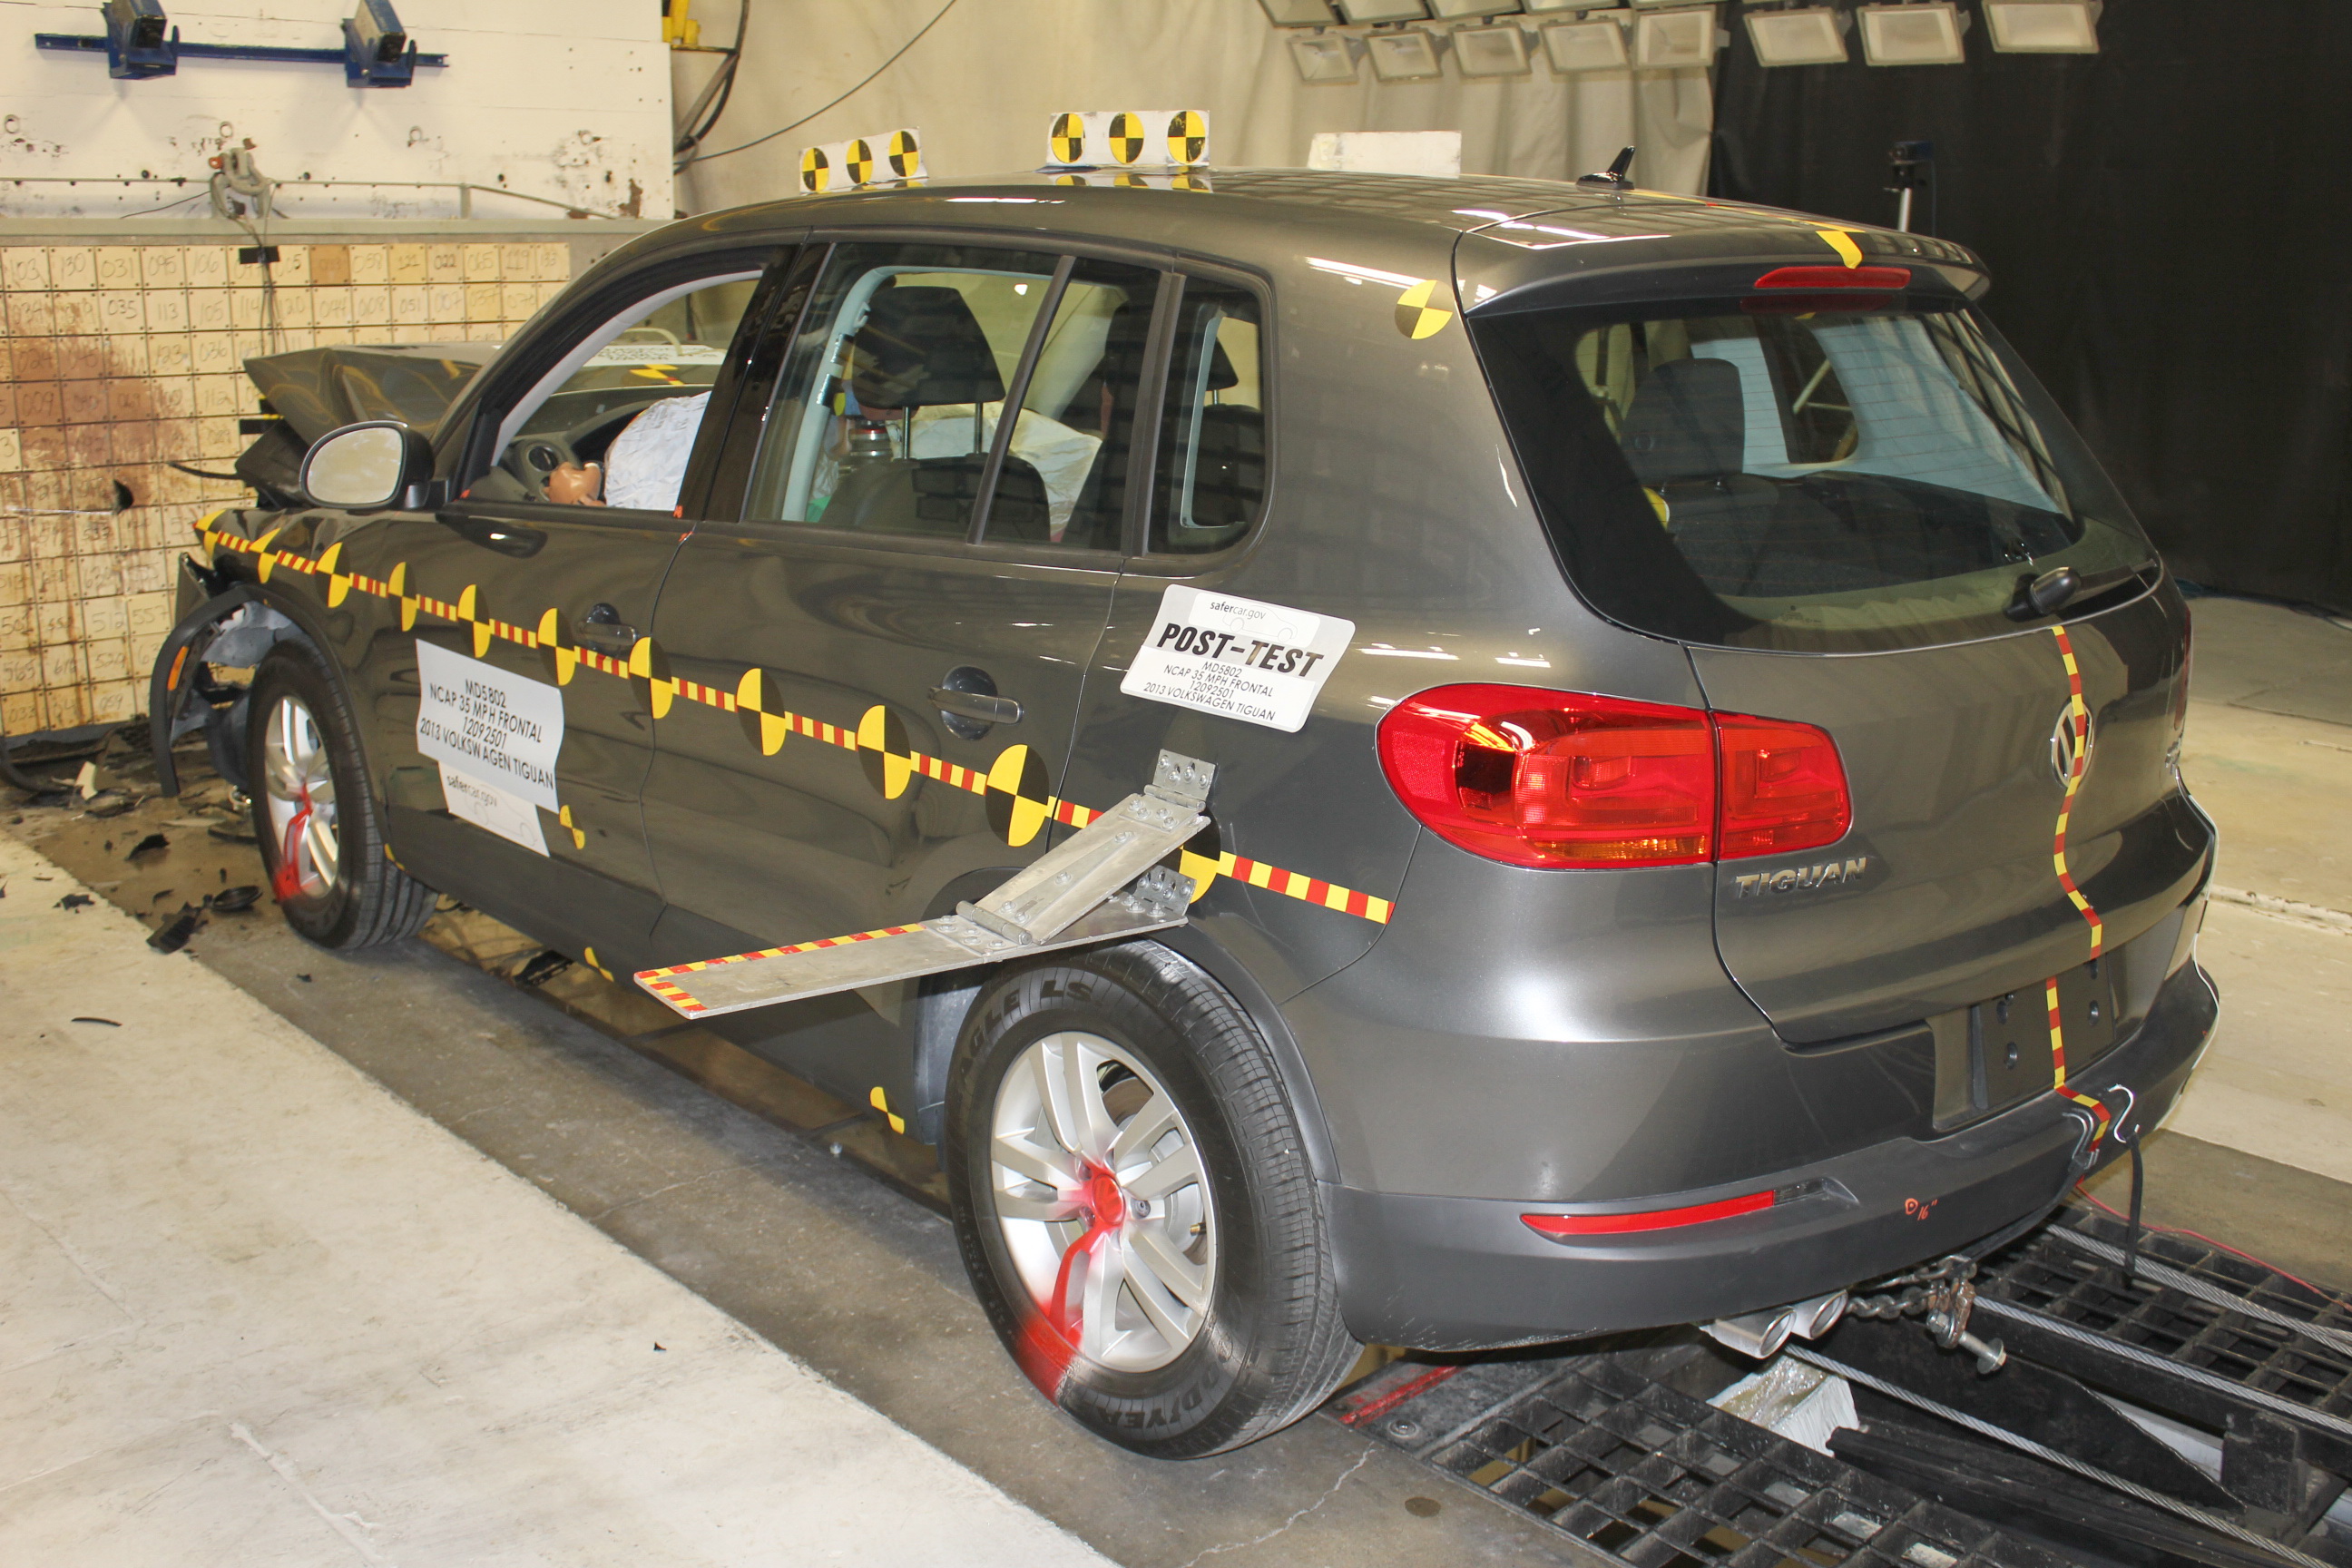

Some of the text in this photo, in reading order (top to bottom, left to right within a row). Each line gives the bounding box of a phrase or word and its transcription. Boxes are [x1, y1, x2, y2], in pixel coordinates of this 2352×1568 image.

[101, 257, 134, 279] 031
[107, 299, 138, 318] 035
[157, 302, 178, 320] 113
[156, 344, 183, 366] 123
[92, 611, 124, 632] 512
[132, 604, 169, 626] 557
[1210, 600, 1267, 621] safercar.gov
[1156, 622, 1325, 678] POST-TEST
[1163, 664, 1274, 698] NCAP 35 MPH FRONTAL
[1201, 662, 1243, 679] MD5802
[466, 679, 507, 709] MD5802
[1142, 681, 1277, 722] 2013 VOLKSWAGEN TIGUAN
[1189, 681, 1235, 700] 12092501
[429, 682, 543, 743] NCAP 35 MPH FRONTAL
[462, 717, 508, 750] 12092501
[419, 718, 555, 790] 2013 VOLKSWAGEN TIGUAN
[1734, 857, 1867, 899] TIGUAN
